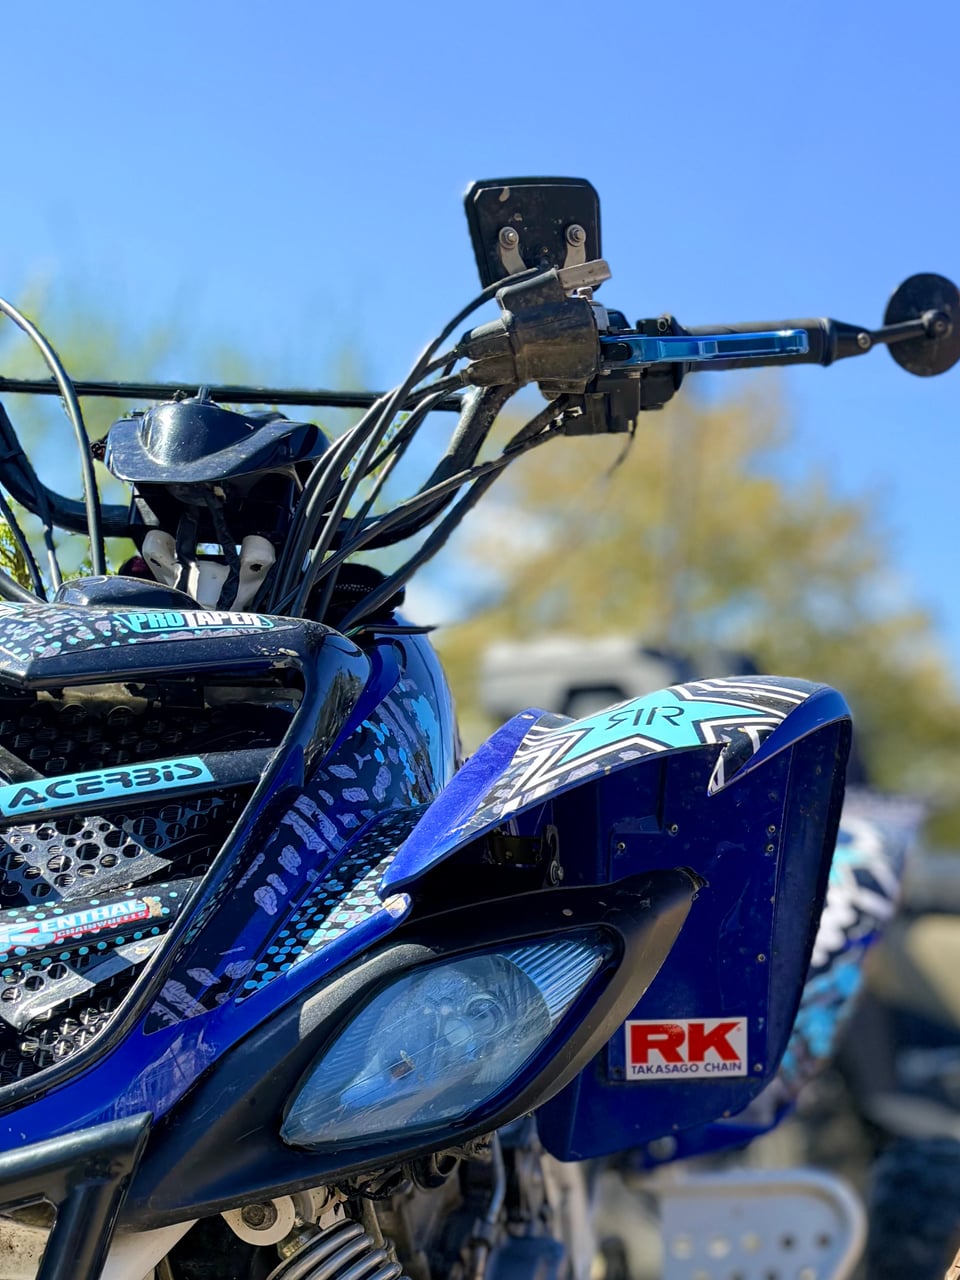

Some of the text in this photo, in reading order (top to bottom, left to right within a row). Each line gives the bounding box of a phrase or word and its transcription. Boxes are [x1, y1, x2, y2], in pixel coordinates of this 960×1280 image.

[128, 611, 261, 630] PROTAPER
[630, 1022, 741, 1064] RK
[631, 1062, 741, 1075] TAKASAGO CHAIN
